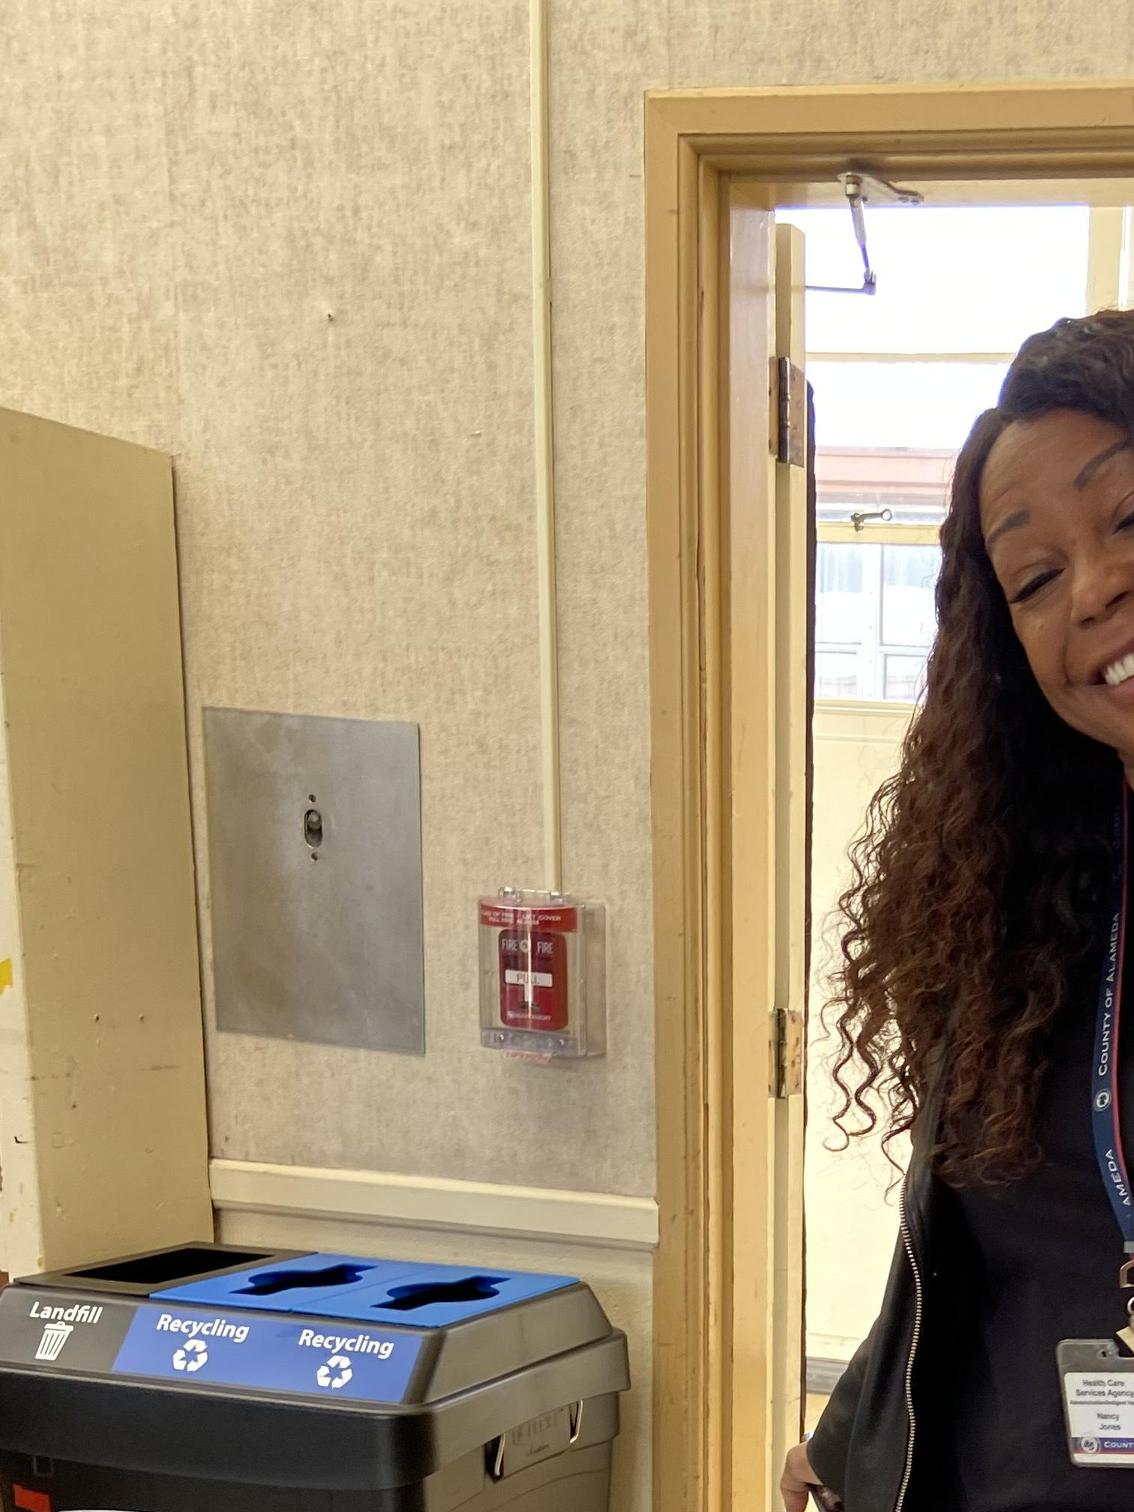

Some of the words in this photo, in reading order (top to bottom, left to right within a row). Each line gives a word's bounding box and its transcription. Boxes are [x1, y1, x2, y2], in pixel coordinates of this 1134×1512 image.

[501, 938, 518, 952] FIRE
[536, 940, 553, 954] FIRE
[1105, 911, 1121, 983] ALAMEDA
[517, 973, 540, 985] PULL
[1104, 987, 1113, 1008] OF
[1098, 1011, 1112, 1077] COUNTY
[29, 1300, 103, 1324] Landfill
[156, 1314, 250, 1344] Recycling
[298, 1328, 395, 1360] Recycling
[1082, 1379, 1106, 1387] Health
[1107, 1379, 1125, 1387] Care
[1075, 1389, 1106, 1397] Services
[1107, 1389, 1134, 1398] Agency
[1096, 1412, 1120, 1421] Nancy
[1099, 1423, 1122, 1431] Jones
